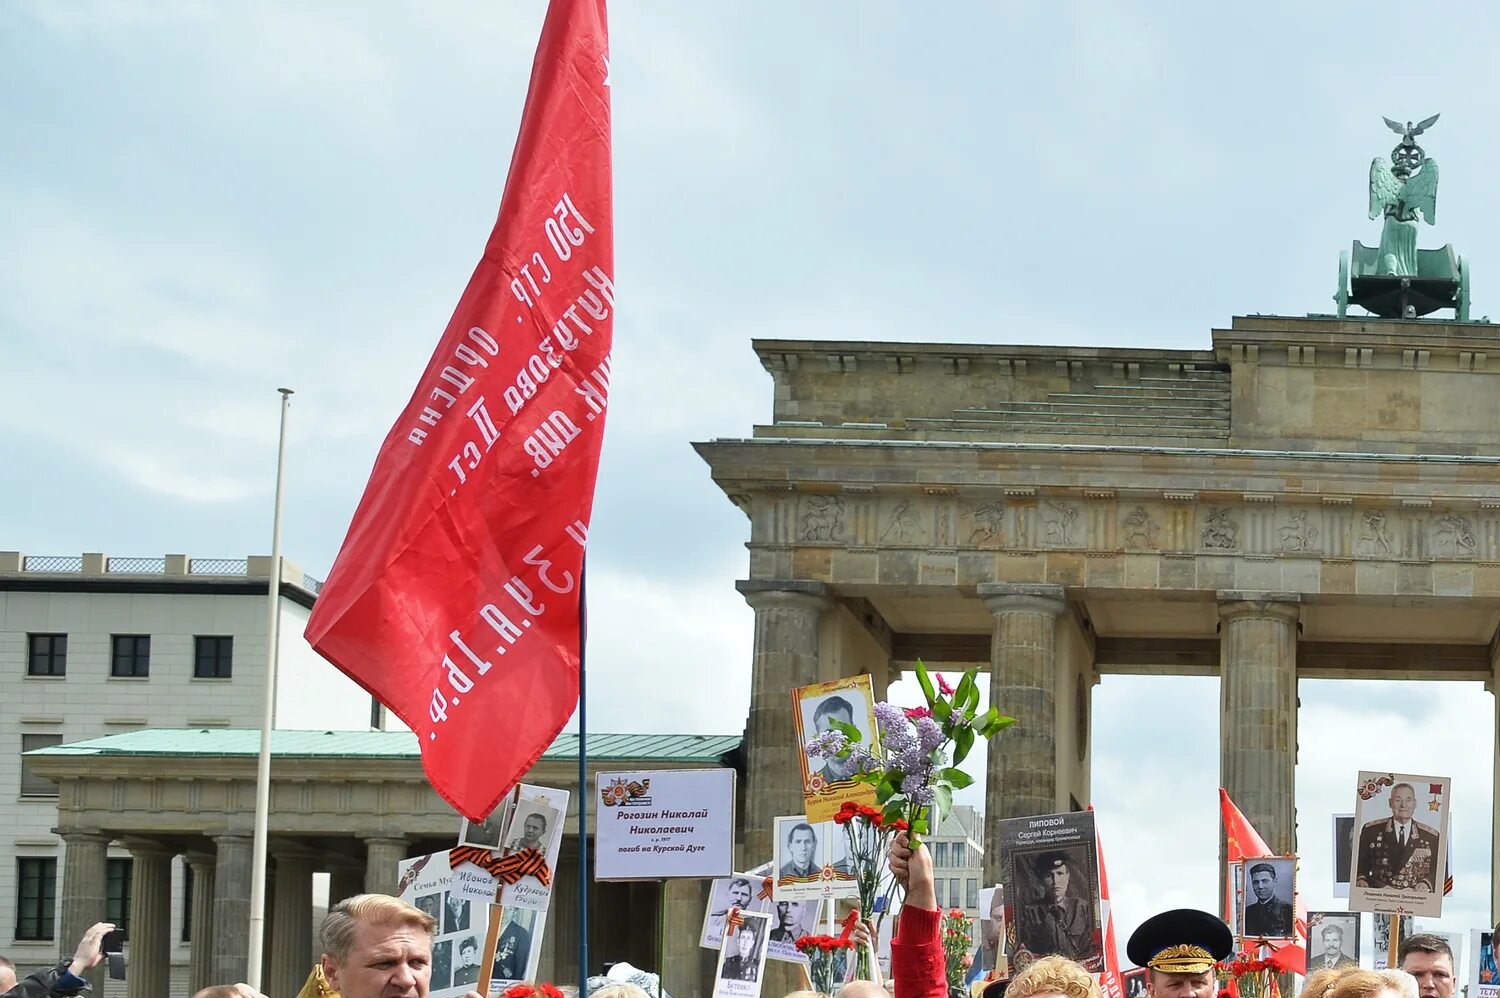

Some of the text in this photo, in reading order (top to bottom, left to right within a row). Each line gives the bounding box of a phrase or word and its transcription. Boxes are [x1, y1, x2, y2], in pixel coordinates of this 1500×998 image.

[617, 808, 709, 820] Рогозин Николай
[1029, 817, 1065, 828] ЛИПОВОЙ
[629, 825, 695, 835] Николаевич
[1018, 827, 1078, 840] Сергей Корнеевич
[618, 845, 640, 853] погиб
[652, 844, 685, 853] Курской
[685, 844, 705, 853] Дуге
[413, 881, 438, 891] Семья
